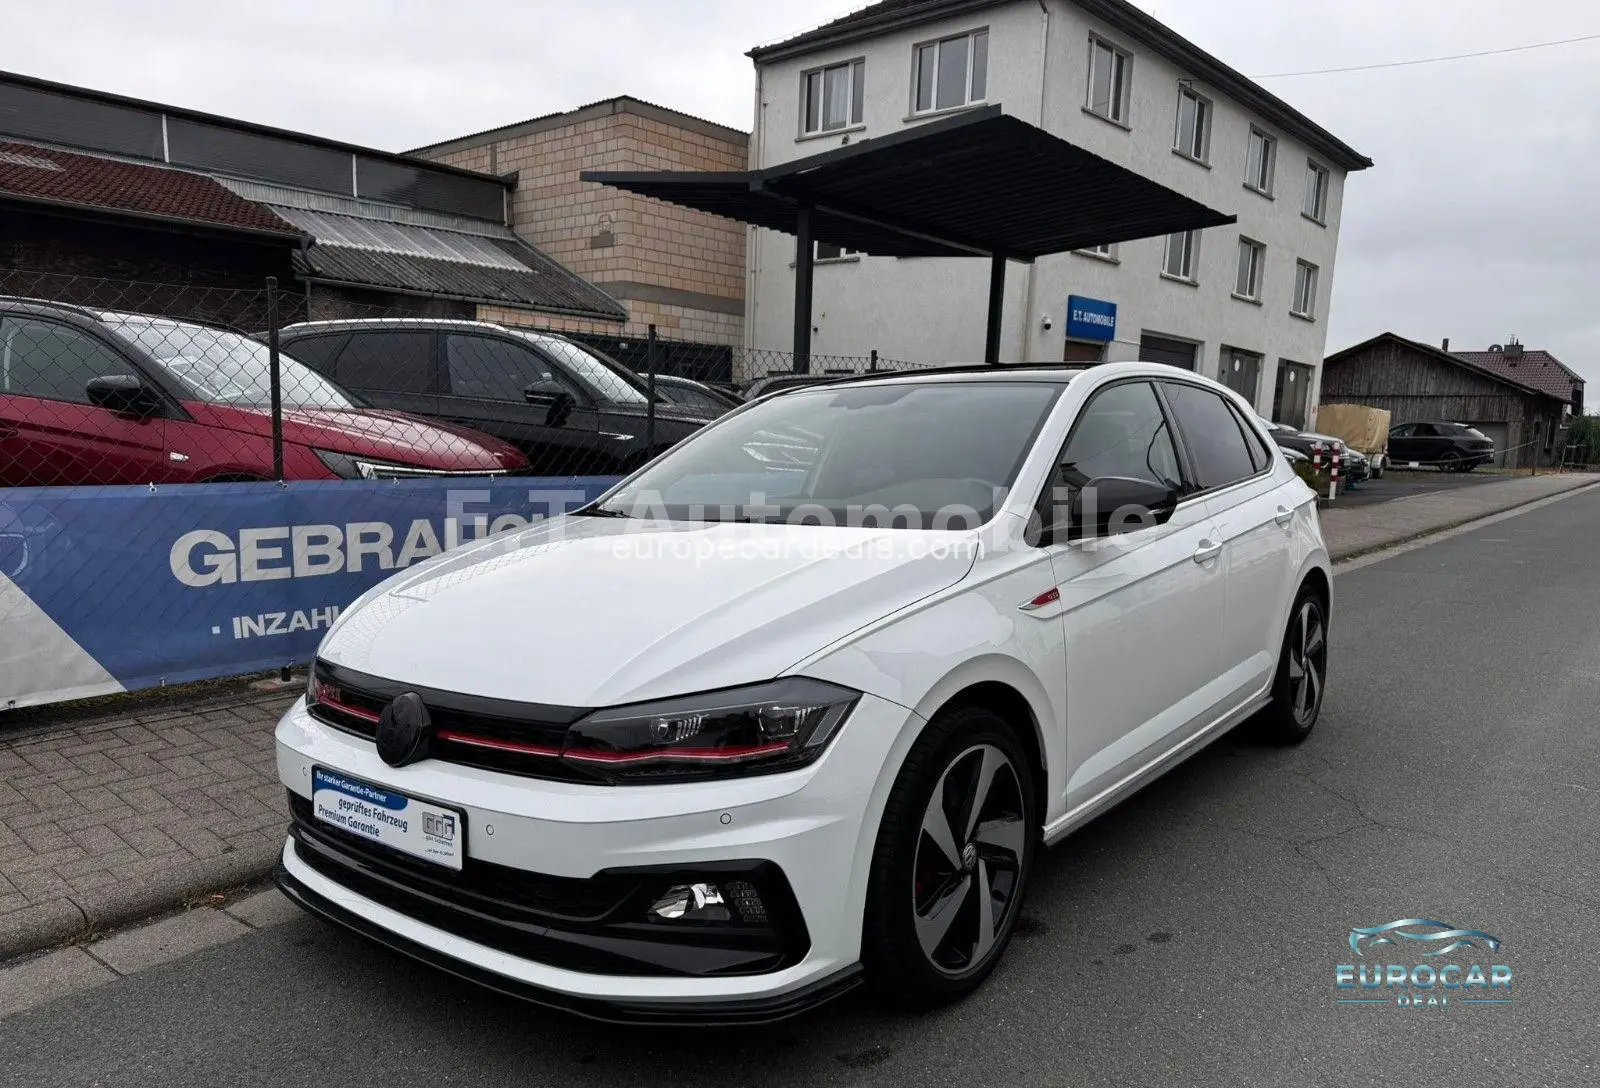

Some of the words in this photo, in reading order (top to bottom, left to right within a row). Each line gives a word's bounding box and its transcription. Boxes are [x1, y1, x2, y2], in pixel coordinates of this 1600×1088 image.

[1083, 312, 1114, 327] AUTOMOBILE
[323, 774, 341, 787] starker
[341, 780, 387, 803] Garantie-Partner
[318, 803, 347, 825] Premium
[347, 816, 380, 837] Garantie
[338, 798, 372, 818] geprüftes
[372, 807, 408, 833] Fahrzeug
